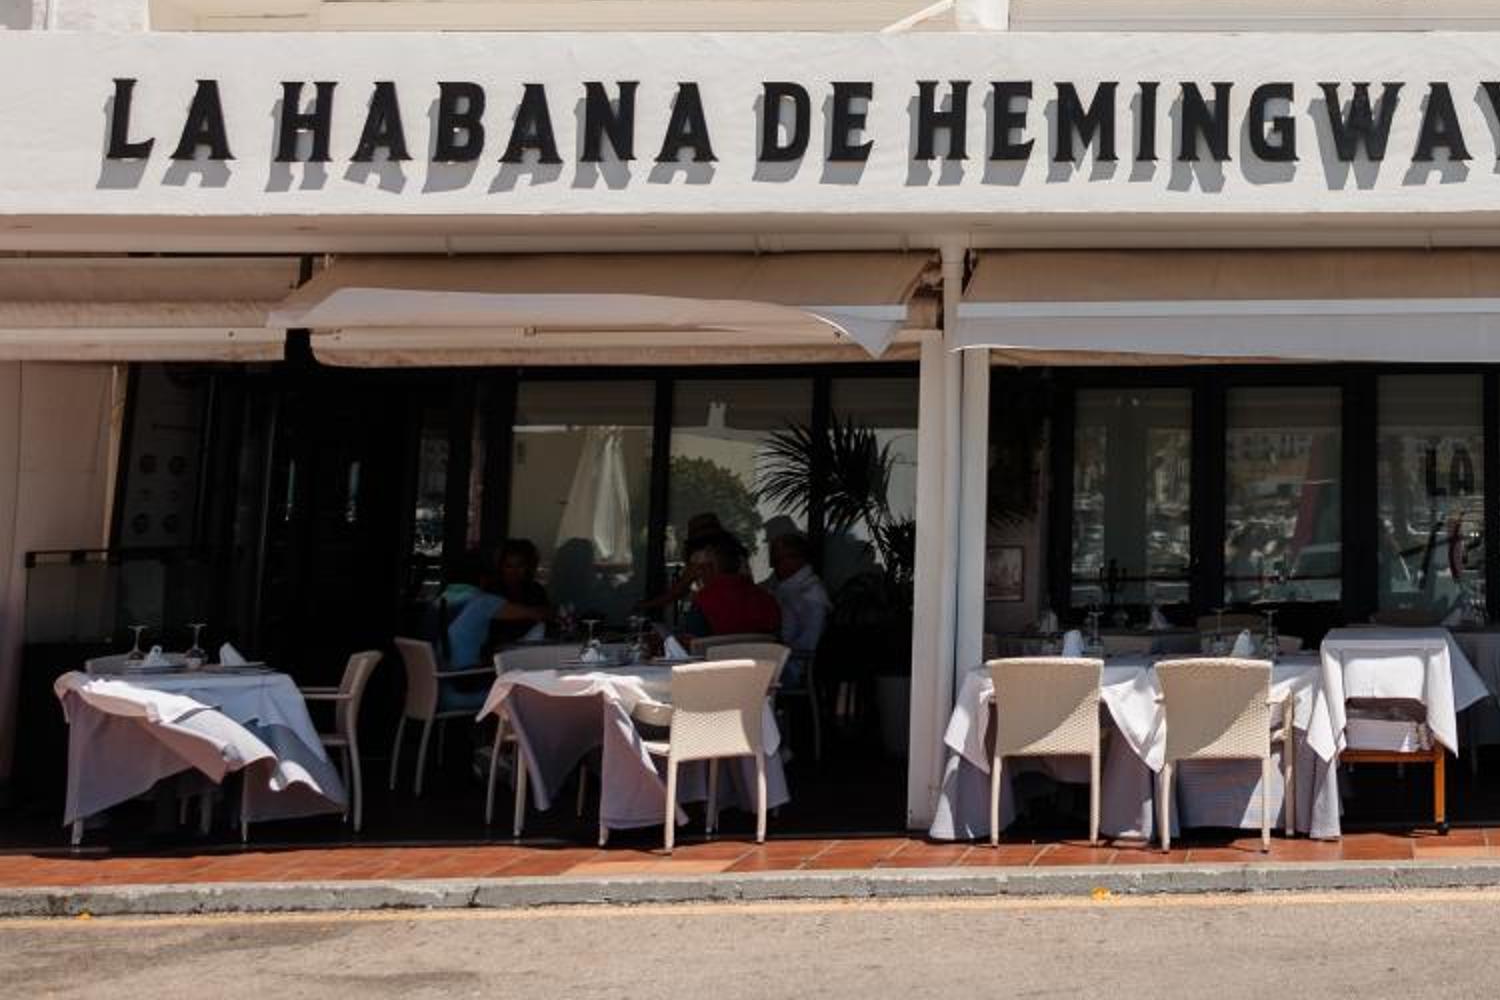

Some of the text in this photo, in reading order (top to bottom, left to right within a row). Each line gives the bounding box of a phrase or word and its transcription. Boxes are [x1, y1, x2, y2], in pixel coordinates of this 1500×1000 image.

[106, 79, 235, 161] LA
[272, 81, 718, 164] HABANA
[758, 81, 874, 163] DE
[1425, 447, 1474, 496] LA
